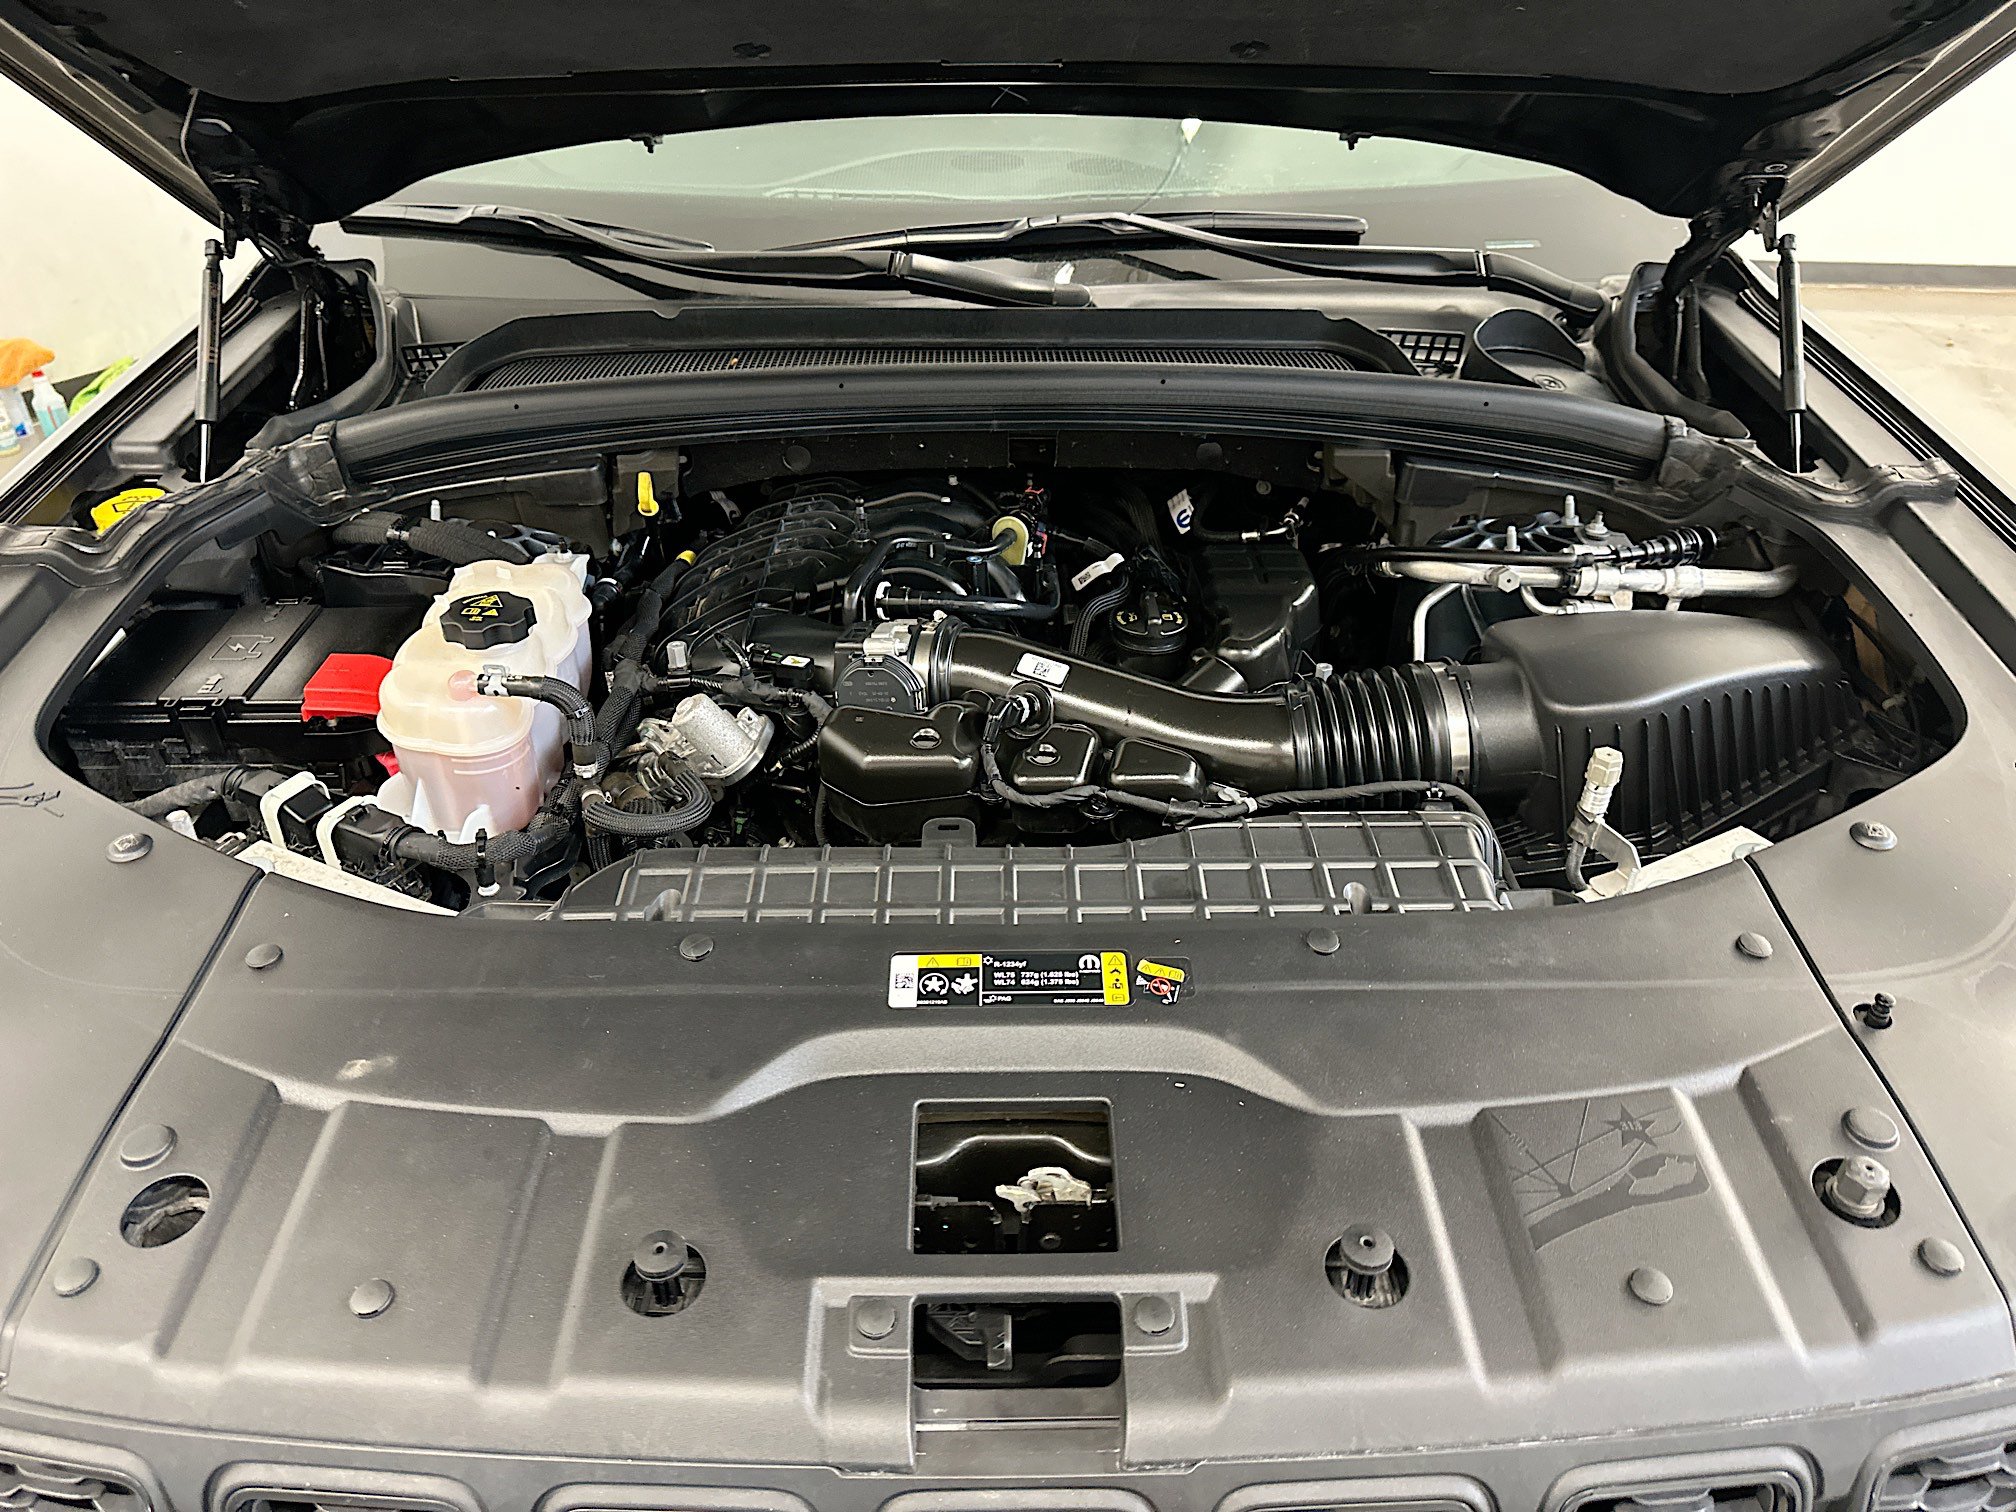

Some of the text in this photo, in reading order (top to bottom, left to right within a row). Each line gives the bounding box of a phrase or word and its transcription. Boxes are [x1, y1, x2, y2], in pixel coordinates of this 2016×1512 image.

[993, 960, 1027, 969] R-1234yf
[993, 971, 1016, 979] WL75
[1020, 971, 1040, 979] 737g
[993, 978, 1016, 986] WL74
[1020, 978, 1040, 987] 624g
